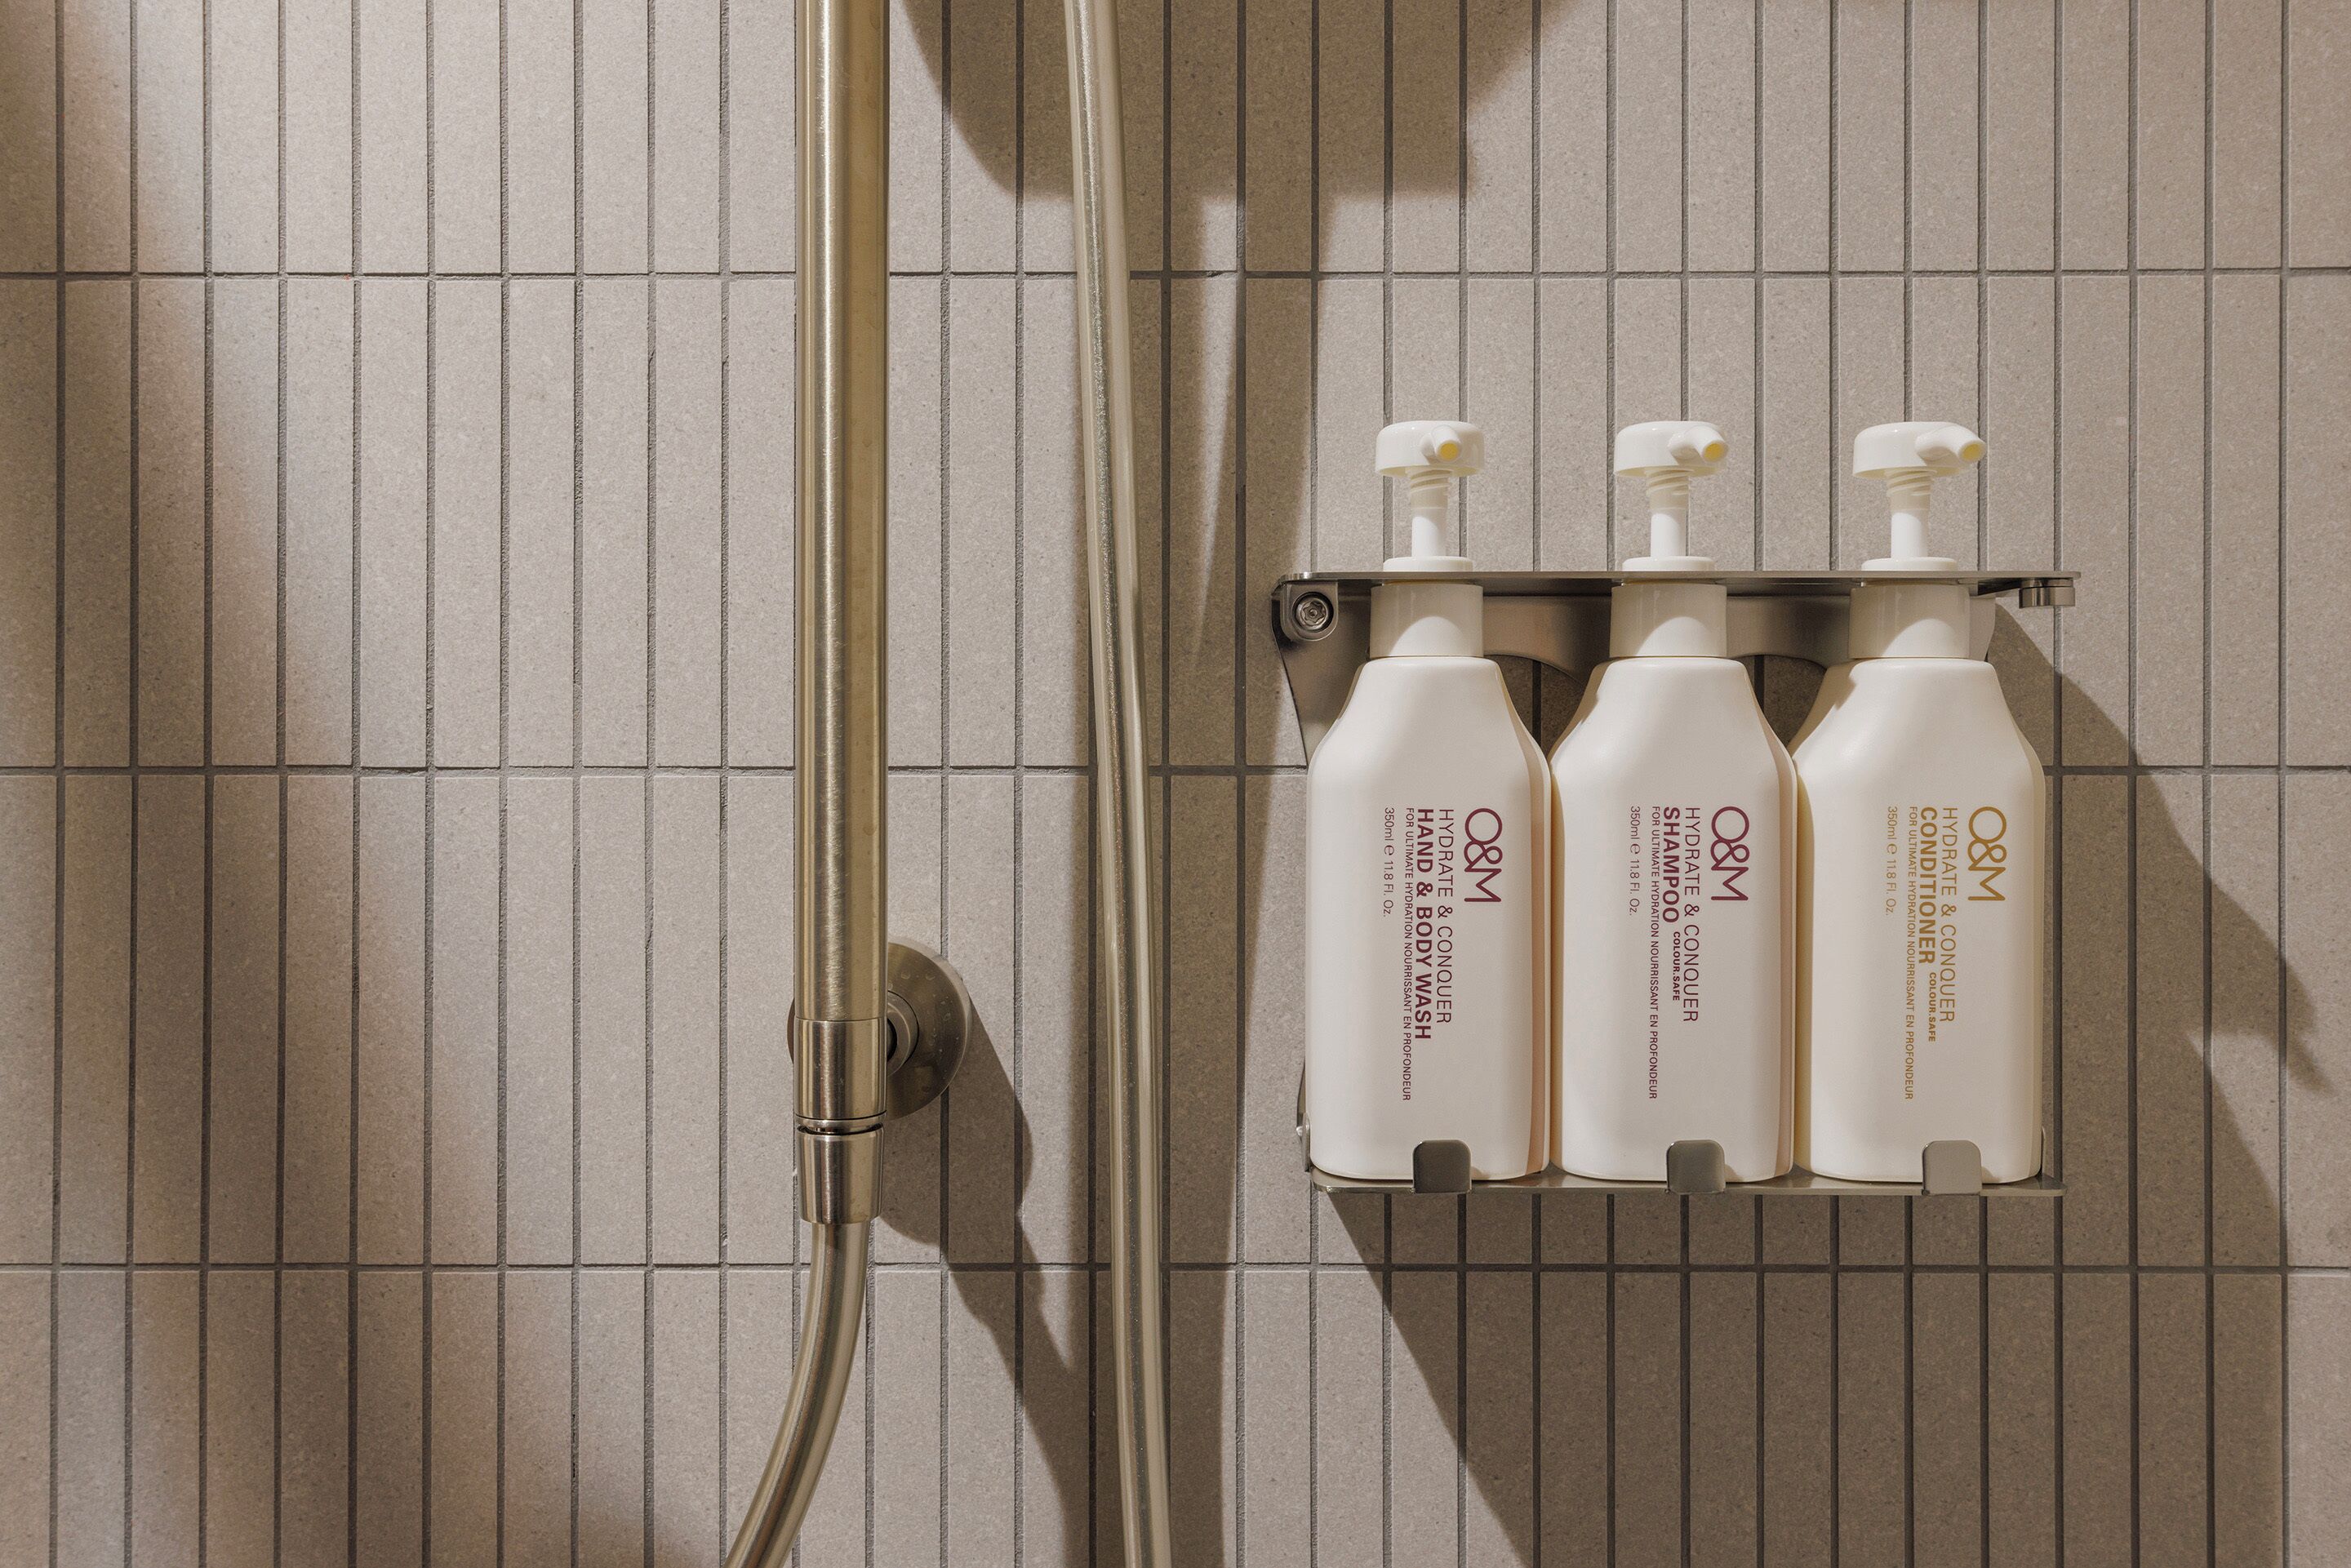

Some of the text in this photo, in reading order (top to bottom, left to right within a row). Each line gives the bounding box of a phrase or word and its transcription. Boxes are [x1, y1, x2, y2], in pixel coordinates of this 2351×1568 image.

[1384, 807, 1394, 840] 350ml
[1631, 806, 1640, 839] 350ml
[1652, 806, 1660, 825] FOR
[1887, 806, 1897, 839] 350ml
[1384, 861, 1393, 880] 11.8
[1464, 808, 1503, 902] O&M
[1630, 860, 1639, 878] 11.8
[1651, 830, 1660, 877] ULTIMATE
[1663, 807, 1680, 922] SHAMPOO
[1710, 806, 1749, 900] O&M
[1887, 860, 1896, 878] 11.8
[1967, 806, 2007, 901] O&M
[1384, 884, 1393, 895] Fl.
[1630, 882, 1639, 894] Fl.
[1887, 882, 1896, 894] Fl.
[1918, 806, 1937, 963] CONDITIONER
[1384, 900, 1393, 917] Oz.
[1415, 809, 1433, 1038] HAND & BODY WASH
[1437, 810, 1454, 1023] HYDRATE & CONQUER
[1629, 899, 1639, 915] Oz.
[1683, 808, 1700, 1021] HYDRATE & CONQUER
[1886, 899, 1896, 915] Oz.
[1940, 808, 1958, 1021] HYDRATE & CONQUER
[1402, 808, 1414, 1100] FOR ULTIMATE HYDRATION NOURRISSANT EN PROFONDEUR
[1905, 806, 1918, 1099] FOR ULTIMATE HYDRATION NOURRISSANT EN PROFONDEUR
[1651, 941, 1659, 1011] NOURRISSANT
[1650, 1015, 1658, 1027] EN
[1649, 1031, 1658, 1099] PROFONDEUR
